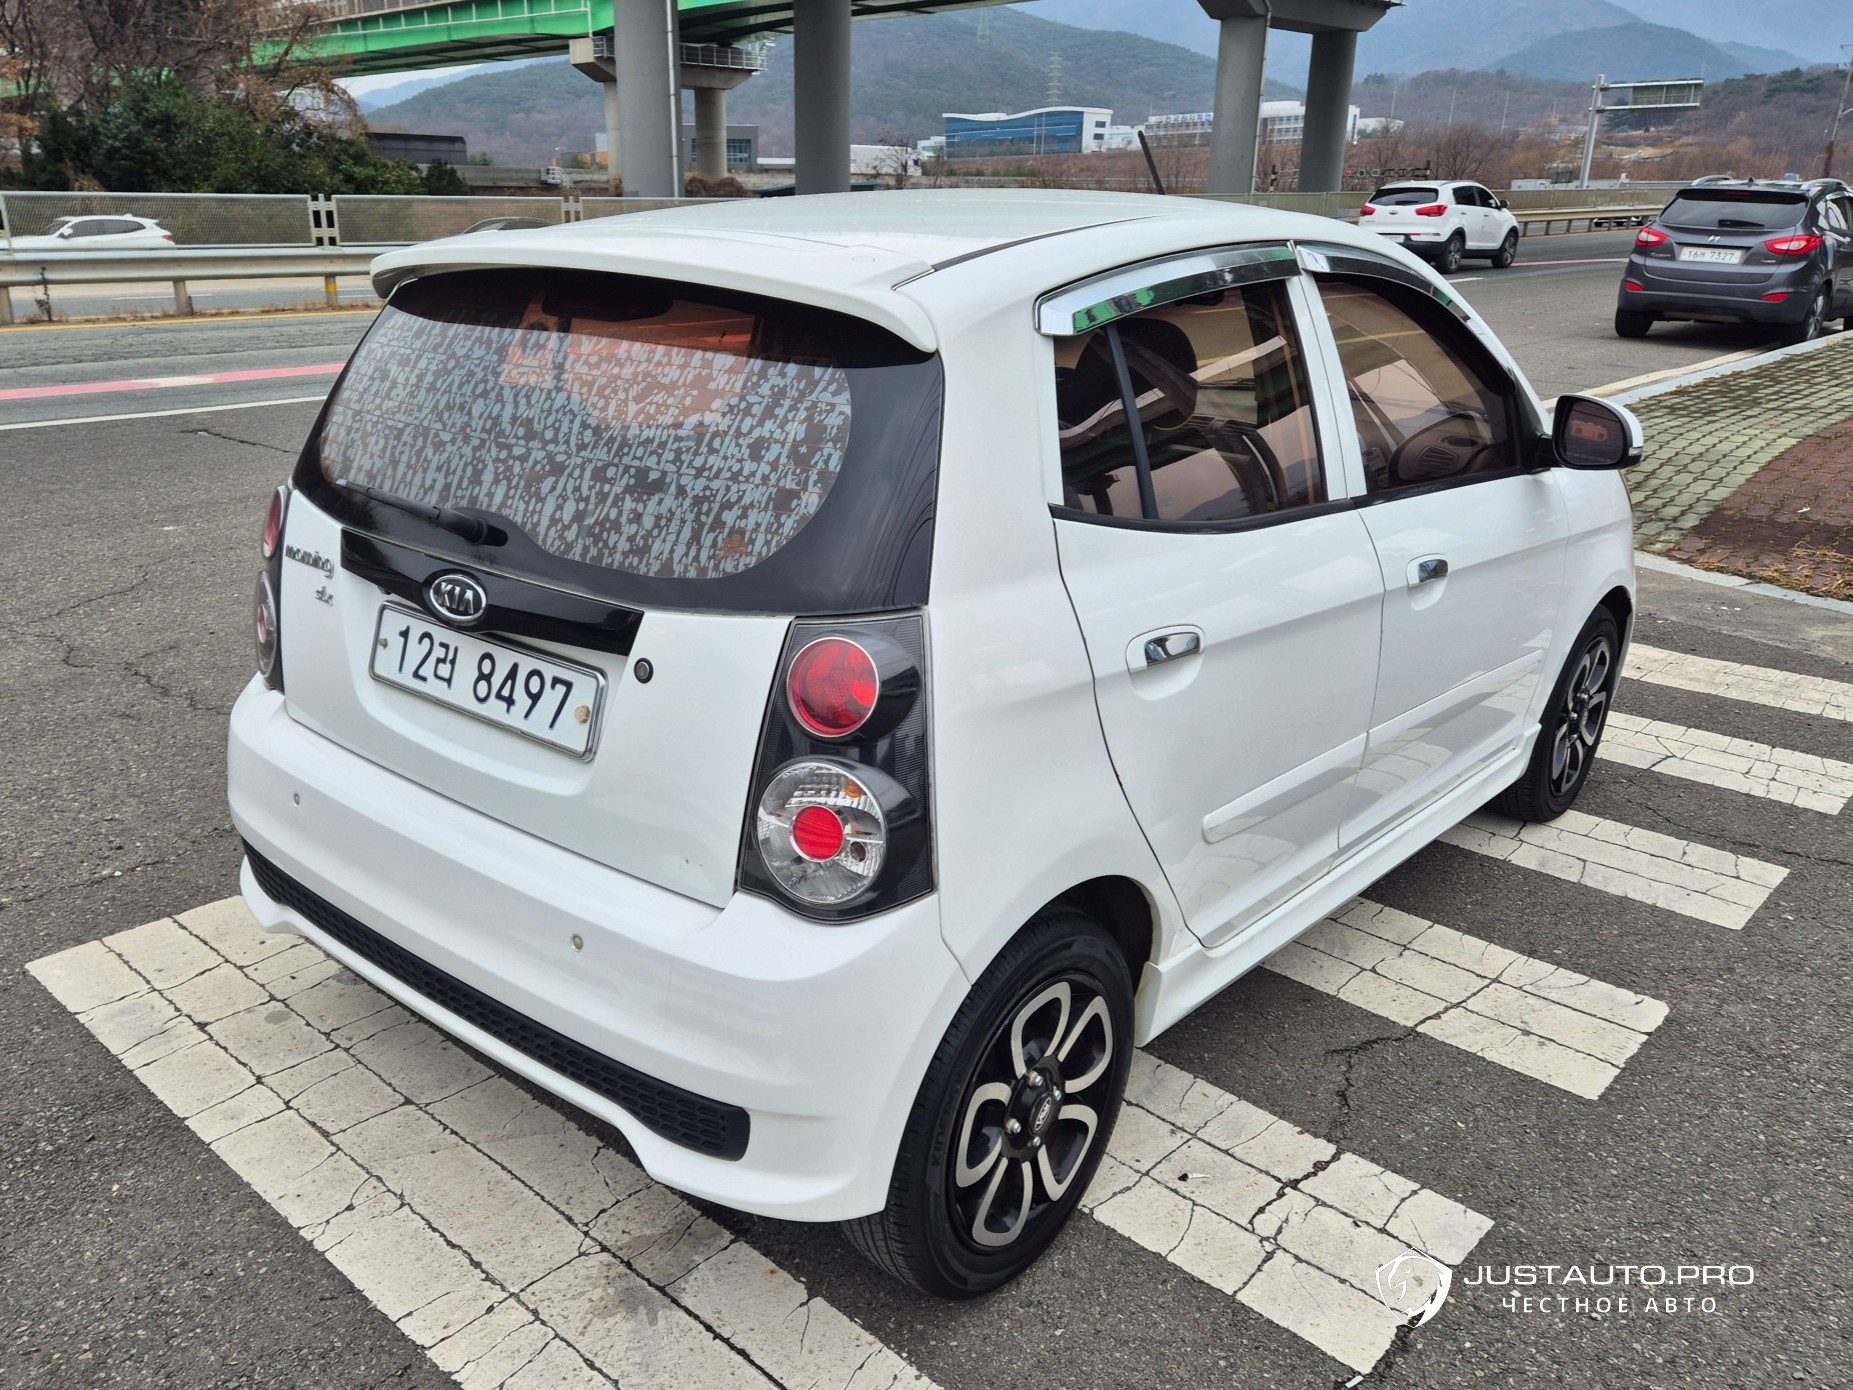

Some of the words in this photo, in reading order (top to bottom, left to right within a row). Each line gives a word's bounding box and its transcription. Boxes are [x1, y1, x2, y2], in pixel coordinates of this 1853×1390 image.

[1709, 251, 1735, 261] 7327
[437, 581, 476, 614] KIA
[398, 625, 459, 690] 12러
[472, 651, 574, 731] 8497
